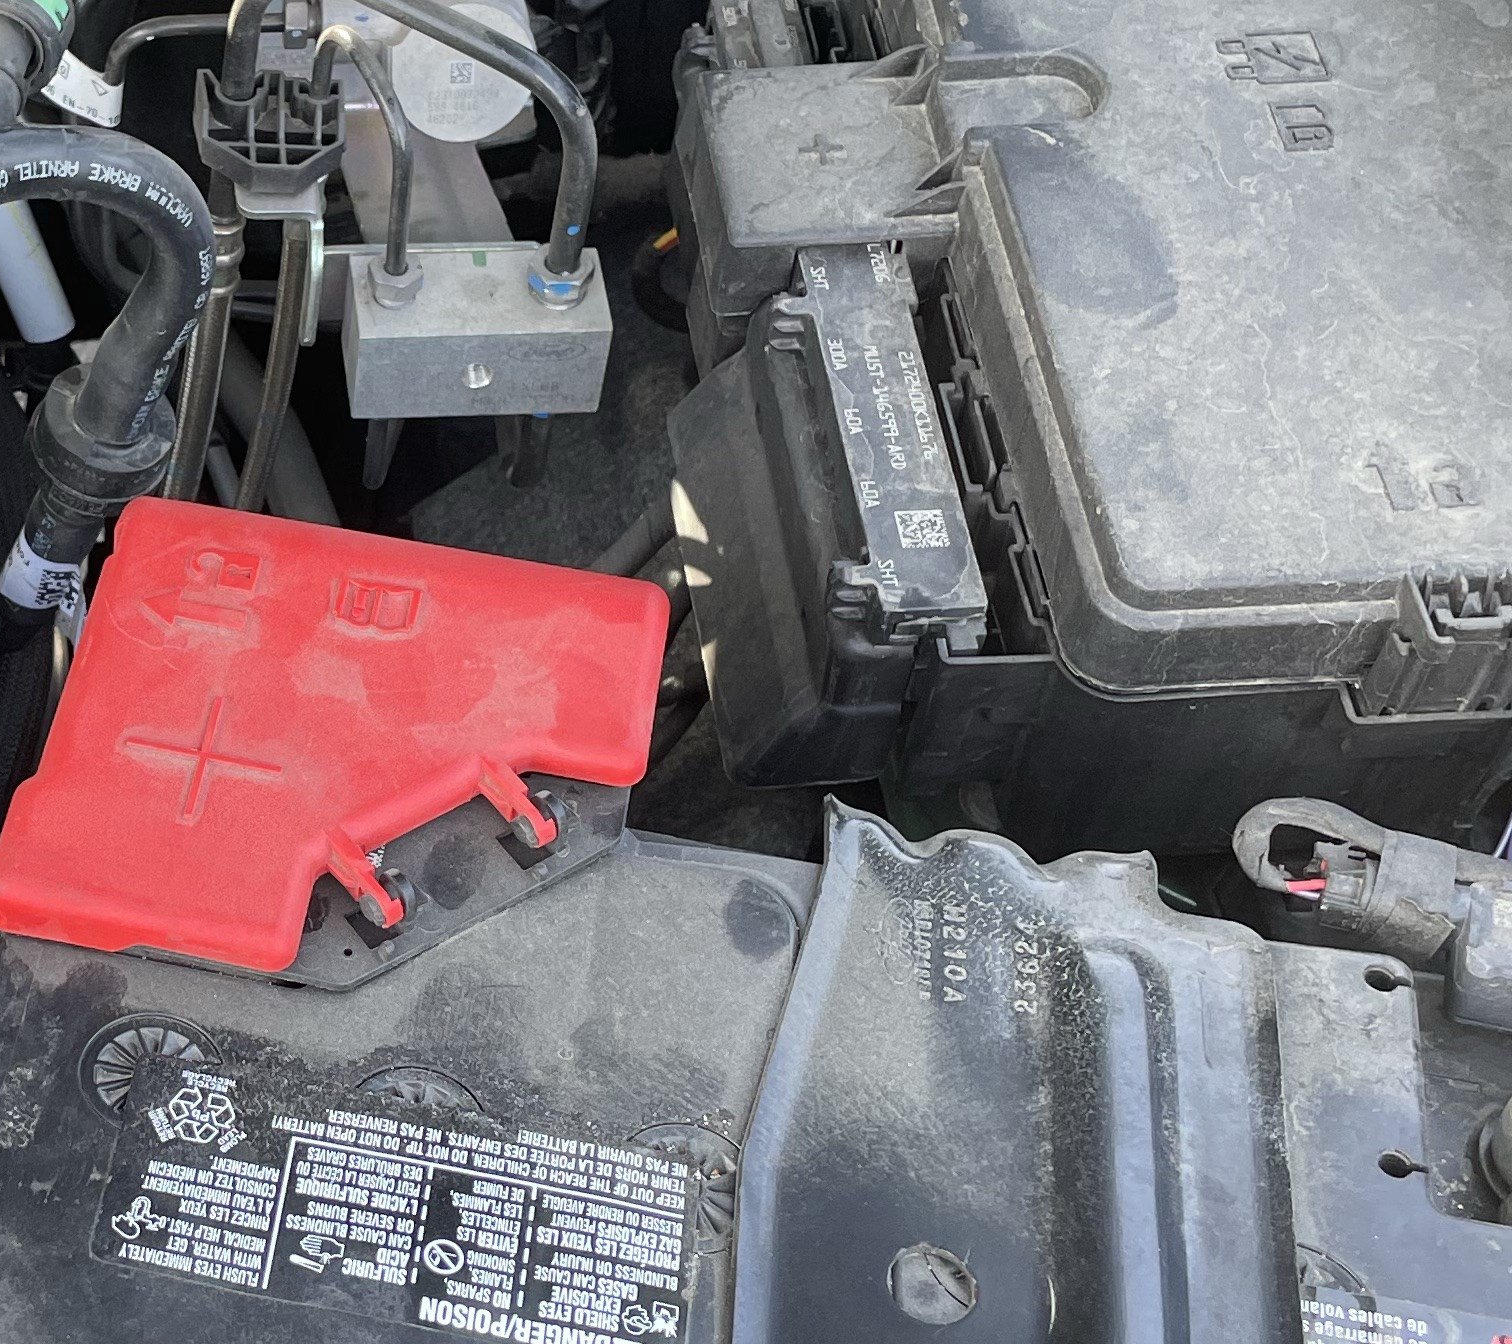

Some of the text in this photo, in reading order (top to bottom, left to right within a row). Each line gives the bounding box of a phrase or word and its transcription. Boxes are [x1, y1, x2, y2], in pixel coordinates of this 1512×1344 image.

[13, 159, 79, 180] ARNITEL
[88, 163, 140, 191] BRAKE
[144, 181, 192, 227] VACUUM
[826, 336, 847, 370] 300A
[843, 407, 863, 435] 60A
[859, 480, 879, 508] 60A
[190, 1106, 212, 1122] Pb
[146, 1159, 276, 1198] CONSULTEZ UN MÉDECIN
[208, 1154, 280, 1182] RAPIDEMENT.
[270, 1114, 685, 1210] KEEP OUT OF THE REACH OF CHILDREN. DO NOT TIP. DO NOT OPEN BATTERY!
[306, 1145, 423, 1181] DES BRÛLURES GRAVES
[140, 1173, 274, 1216] À L'EAU IMMÉDIATEMENT.
[294, 1176, 418, 1215] L'ACIDE SULFURIQUE
[449, 1188, 523, 1219] LES FLAMMES,
[471, 1179, 525, 1203] DE FUMER
[177, 1197, 270, 1231] RINCEZ LES YEUX
[306, 1200, 414, 1234] OR SEVERE BURNS
[457, 1207, 521, 1238] ÉTINCELLES,
[166, 1216, 266, 1253] MEDICAL HELP FAST.
[284, 1213, 412, 1250] CAN CAUSE BLINDNESS
[455, 1225, 519, 1256] ÉVITER LES
[535, 1224, 680, 1271] PROTÉGEZ LES YEUX LES
[549, 1211, 681, 1254] GAZ EXPLOSIFS PEUVENT
[117, 1241, 259, 1287] FLUSH EYES IMMEDIATELY
[164, 1234, 261, 1270] WITH WATER. GET
[375, 1246, 410, 1268] ACID
[465, 1249, 515, 1274] SMOKING
[340, 1257, 407, 1285] SULFURIC
[467, 1265, 513, 1290] FLAMES,
[532, 1263, 638, 1301] GASES CAN CAUSE
[550, 1251, 678, 1291] BLINDNESS OR INJURY
[443, 1276, 511, 1310] NO SPARKS,
[550, 1284, 621, 1315] EXPLOSIVE
[537, 1299, 620, 1332] SHIELD EYES
[1347, 1307, 1404, 1333] cables
[1406, 1317, 1427, 1338] de
